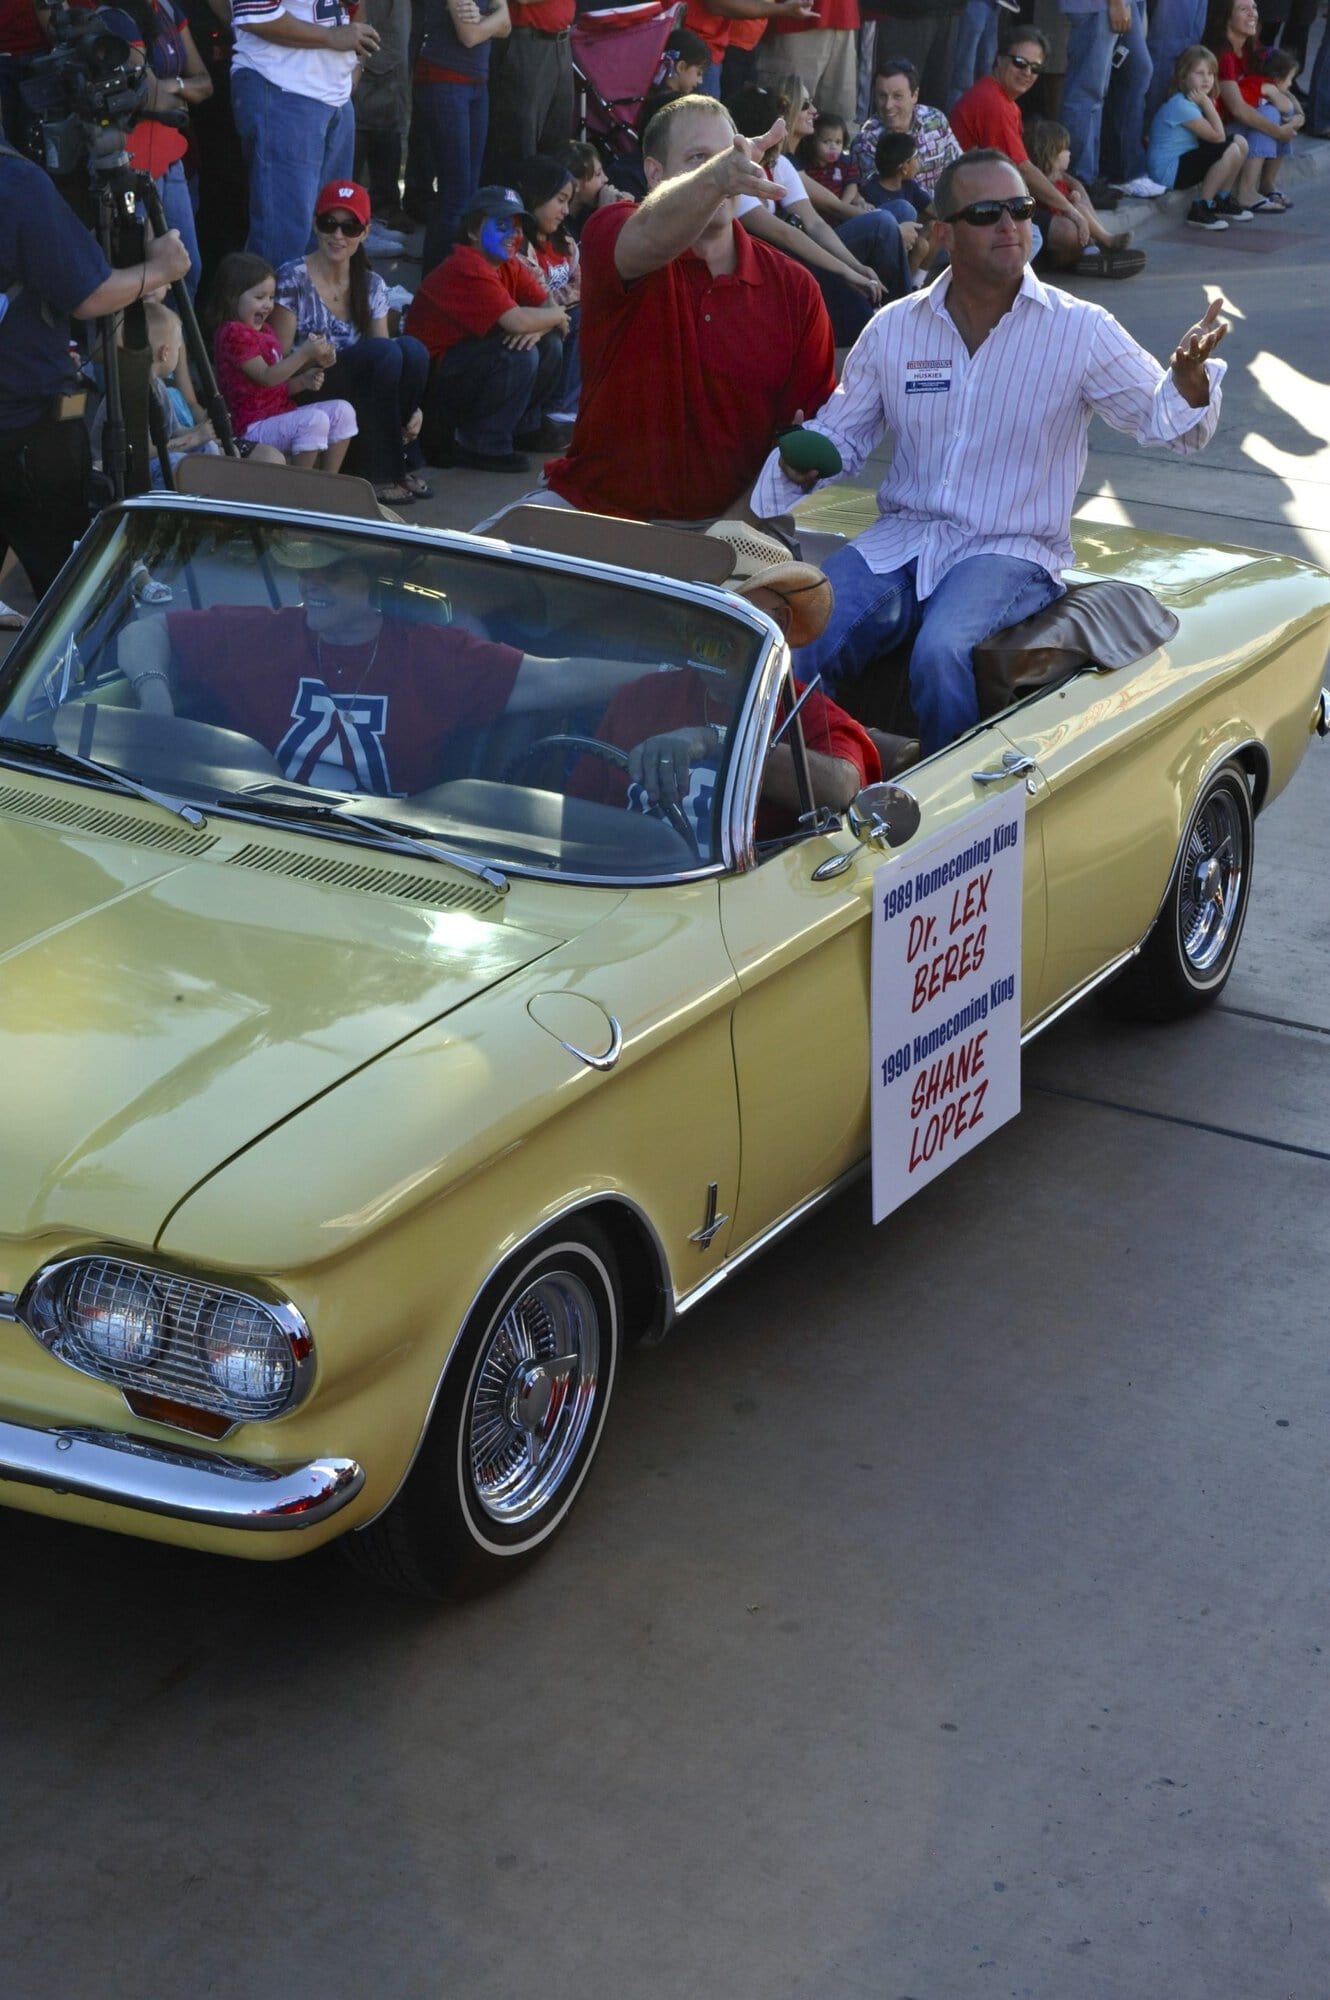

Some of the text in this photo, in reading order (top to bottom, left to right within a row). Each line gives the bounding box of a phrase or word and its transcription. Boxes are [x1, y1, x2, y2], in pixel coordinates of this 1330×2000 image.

[338, 187, 355, 198] W
[272, 677, 409, 799] A
[883, 820, 1018, 922] 1989 Homecoming King
[906, 868, 993, 963] Dr. LEX
[911, 923, 987, 1013] BERES
[881, 974, 1015, 1087] 1990 Homecoming King
[910, 1029, 989, 1119] SHANE
[908, 1078, 989, 1174] LOPEZ
